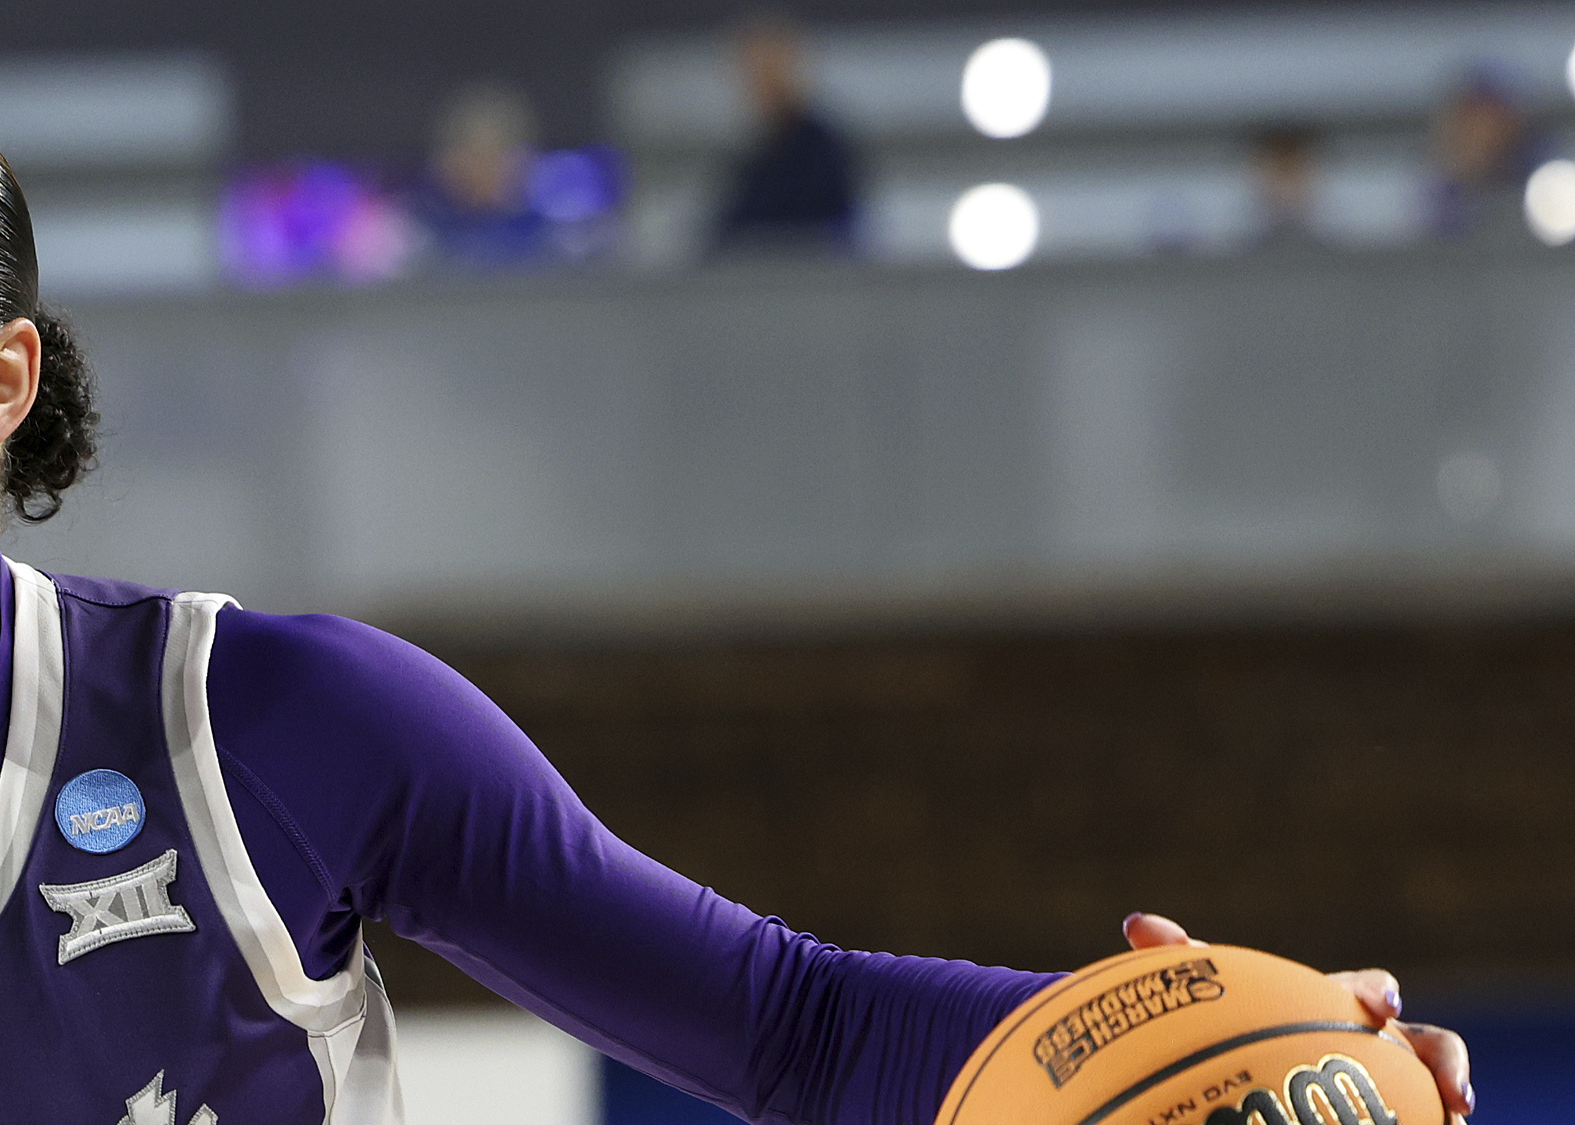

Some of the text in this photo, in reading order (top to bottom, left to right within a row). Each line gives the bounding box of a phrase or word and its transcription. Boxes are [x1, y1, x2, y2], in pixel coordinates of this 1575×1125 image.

[70, 803, 141, 836] NCAA
[61, 862, 181, 948] XII
[1088, 979, 1194, 1050] MARCH
[1203, 1070, 1254, 1102] EVO
